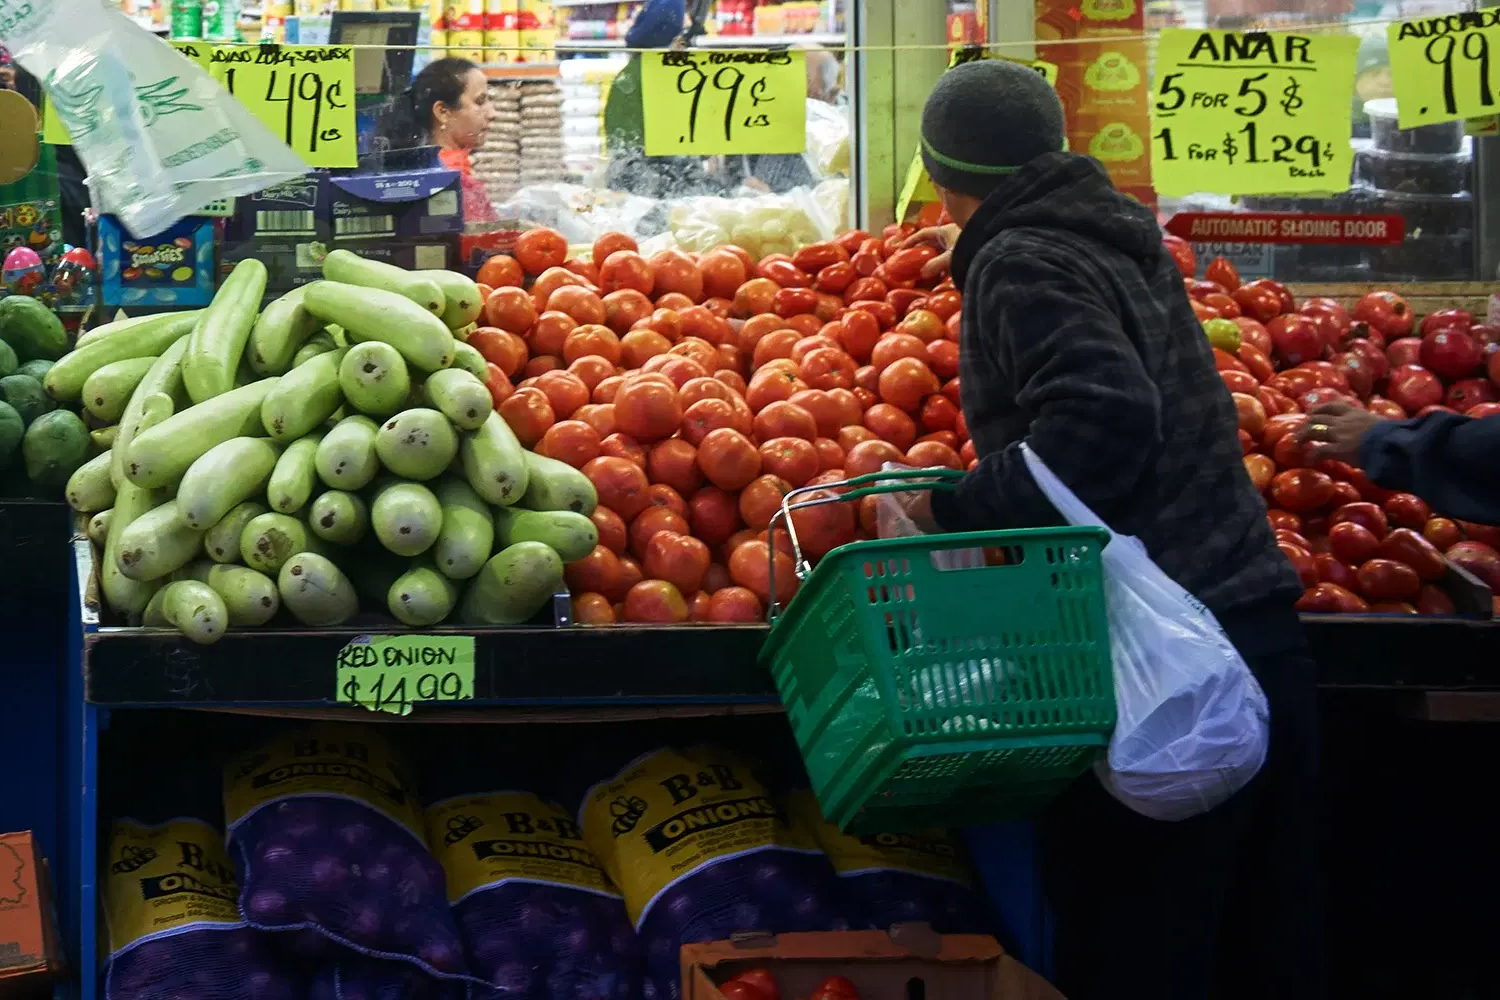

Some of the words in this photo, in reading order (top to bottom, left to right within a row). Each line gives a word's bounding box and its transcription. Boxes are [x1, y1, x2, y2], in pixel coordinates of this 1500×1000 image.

[1188, 32, 1316, 64] ANAR
[1156, 73, 1186, 111] 5
[1191, 92, 1229, 108] FOR
[1234, 72, 1269, 117] 5
[1153, 128, 1179, 161] 1
[1191, 219, 1278, 236] AUTOMATIC
[1280, 220, 1341, 237] SLIDING
[1344, 221, 1387, 238] DOOR
[337, 645, 379, 669] RED
[383, 646, 457, 668] ONION
